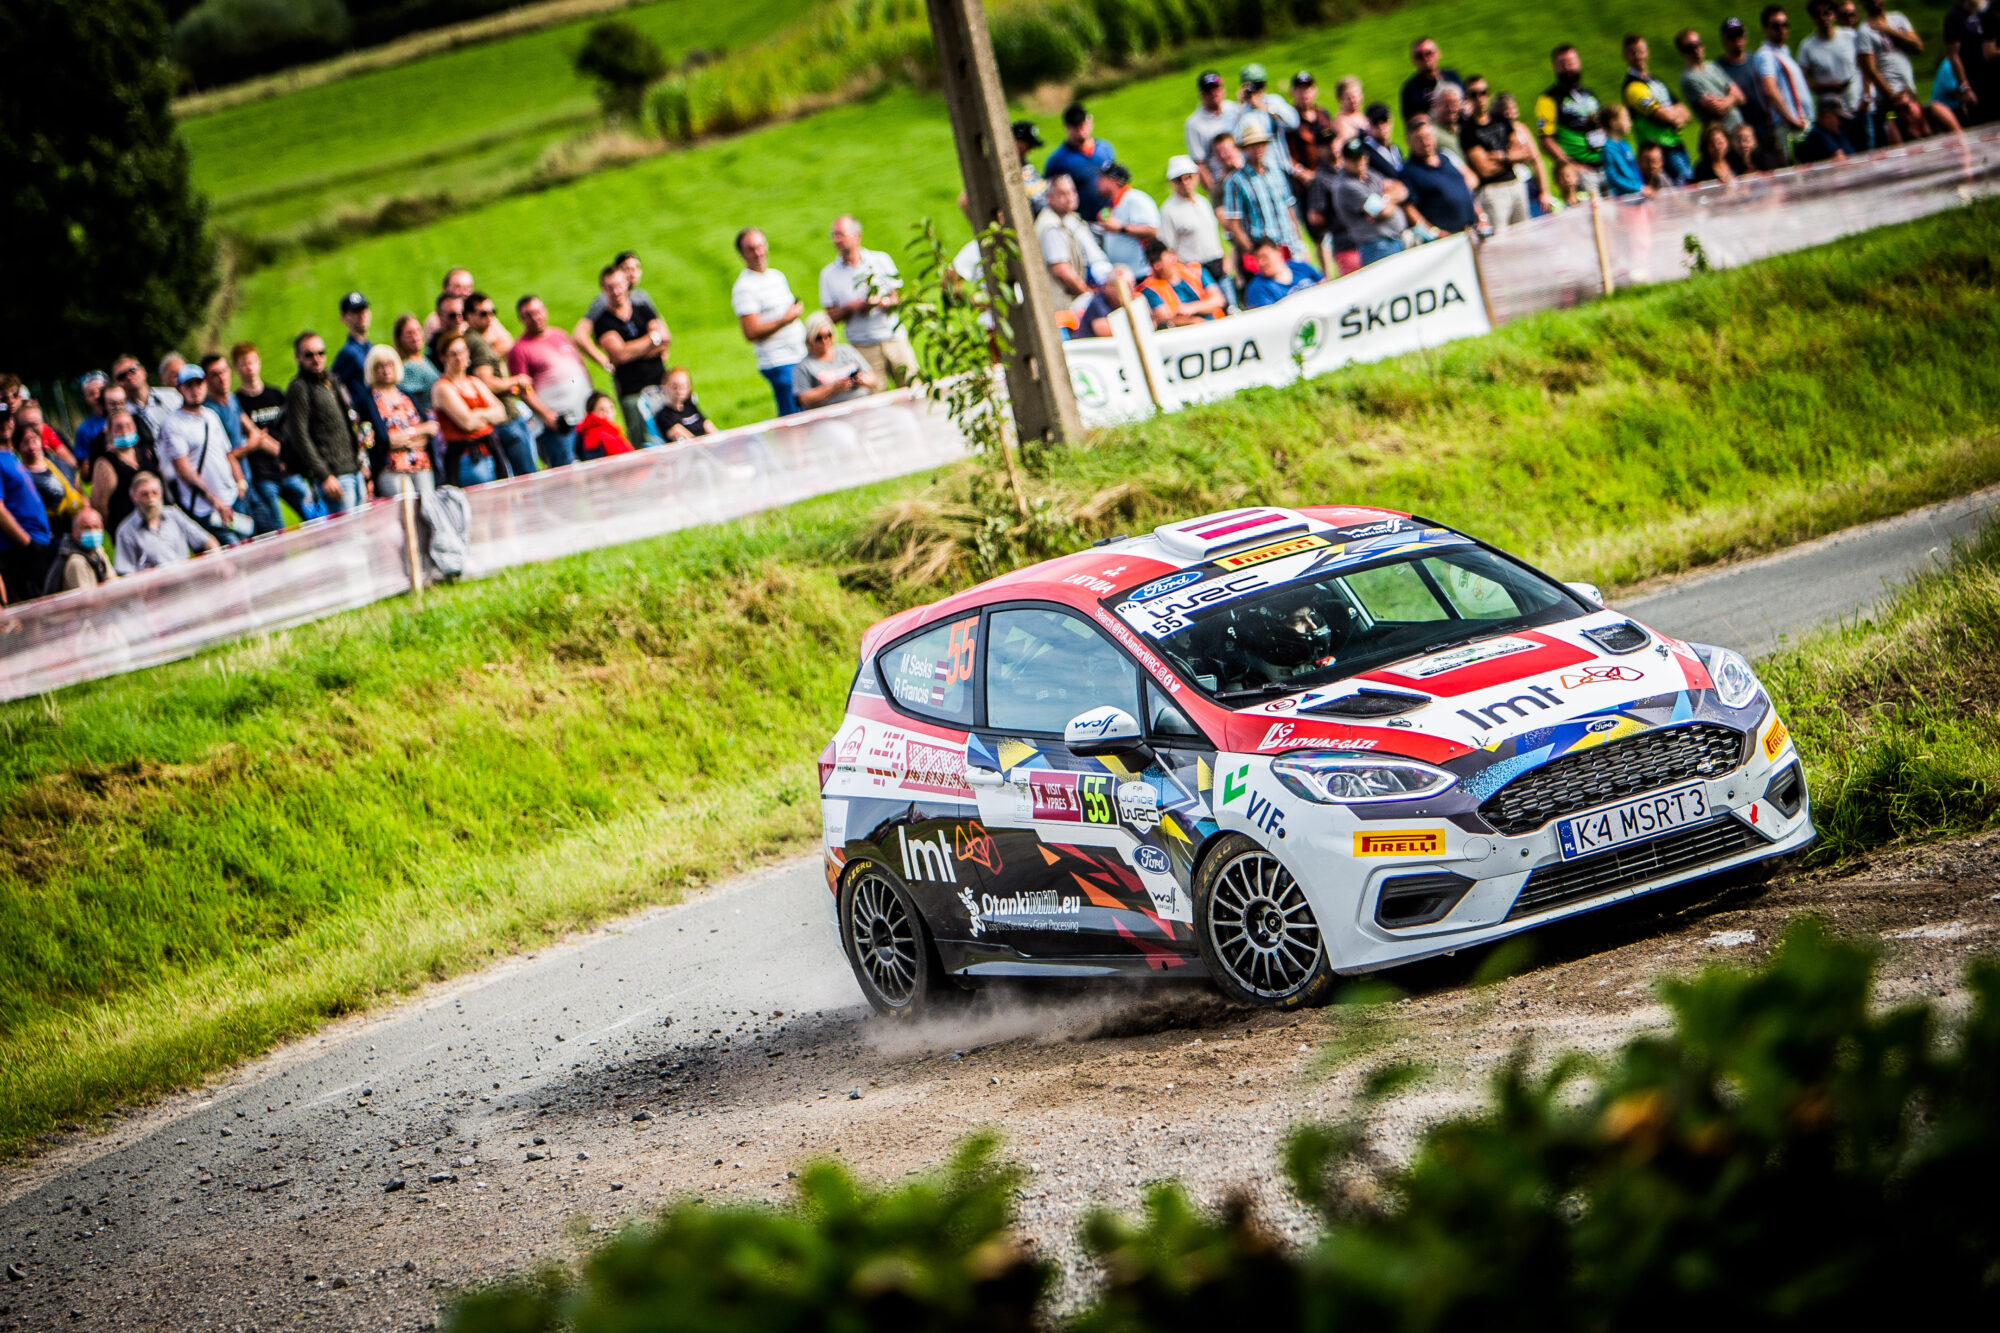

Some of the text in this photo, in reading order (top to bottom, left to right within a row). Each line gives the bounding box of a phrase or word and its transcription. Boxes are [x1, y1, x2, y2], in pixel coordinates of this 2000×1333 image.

[1339, 282, 1465, 340] ŠKODA
[1062, 573, 1117, 595] LATVIJA
[1143, 574, 1190, 598] Ford
[1118, 602, 1137, 613] P4
[1148, 575, 1269, 618] WRC
[1094, 607, 1115, 632] Search
[1152, 616, 1183, 634] 55
[945, 615, 979, 686] 55
[900, 653, 933, 679] M Sesks
[893, 677, 901, 698] R
[900, 679, 930, 705] Francis
[1044, 782, 1061, 795] VISIT
[1046, 796, 1067, 810] YPRES
[1083, 776, 1110, 824] 55
[1121, 806, 1159, 823] WRC
[1361, 834, 1437, 852] PIRELLI
[1565, 842, 1575, 852] PL
[1140, 848, 1165, 870] Ford
[851, 861, 872, 880] ZERO
[1033, 919, 1047, 931] Grain
[1048, 919, 1079, 933] Processing
